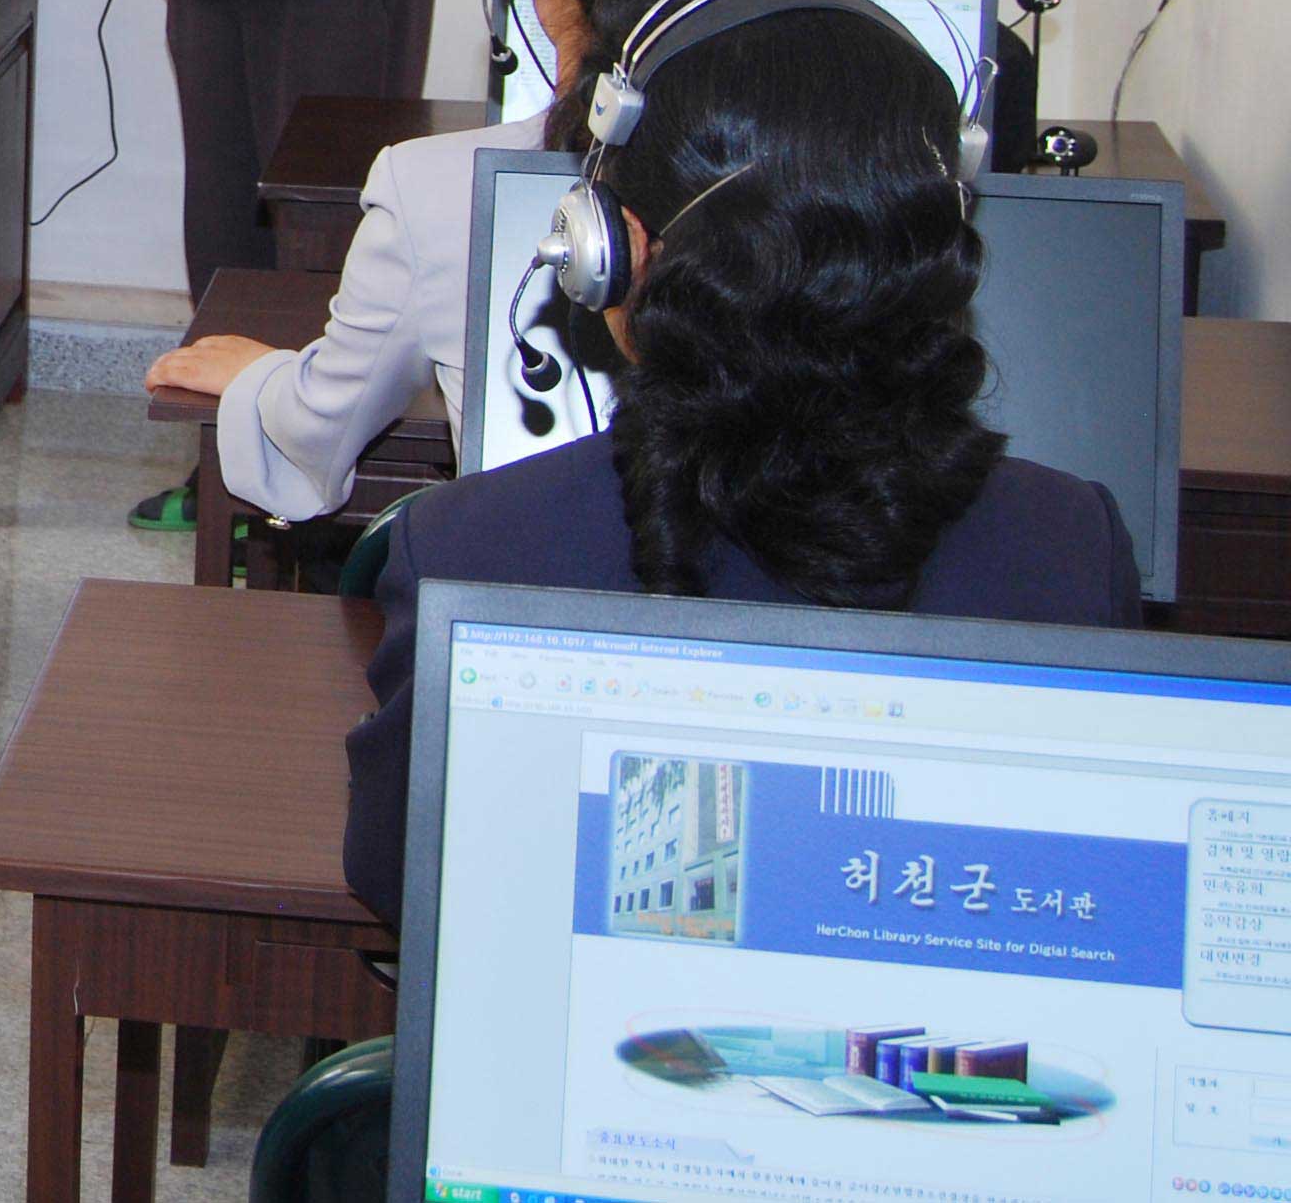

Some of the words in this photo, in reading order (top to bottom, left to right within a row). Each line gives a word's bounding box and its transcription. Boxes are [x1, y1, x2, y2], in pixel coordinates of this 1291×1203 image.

[840, 849, 997, 911] 허천군
[1011, 887, 1097, 920] 도서관
[816, 924, 870, 940] HerChon
[874, 929, 920, 946] Library
[925, 934, 972, 948] Service
[977, 938, 1001, 951] Site
[1006, 941, 1025, 953] for
[1071, 947, 1115, 961] Search
[451, 1186, 482, 1201] start
